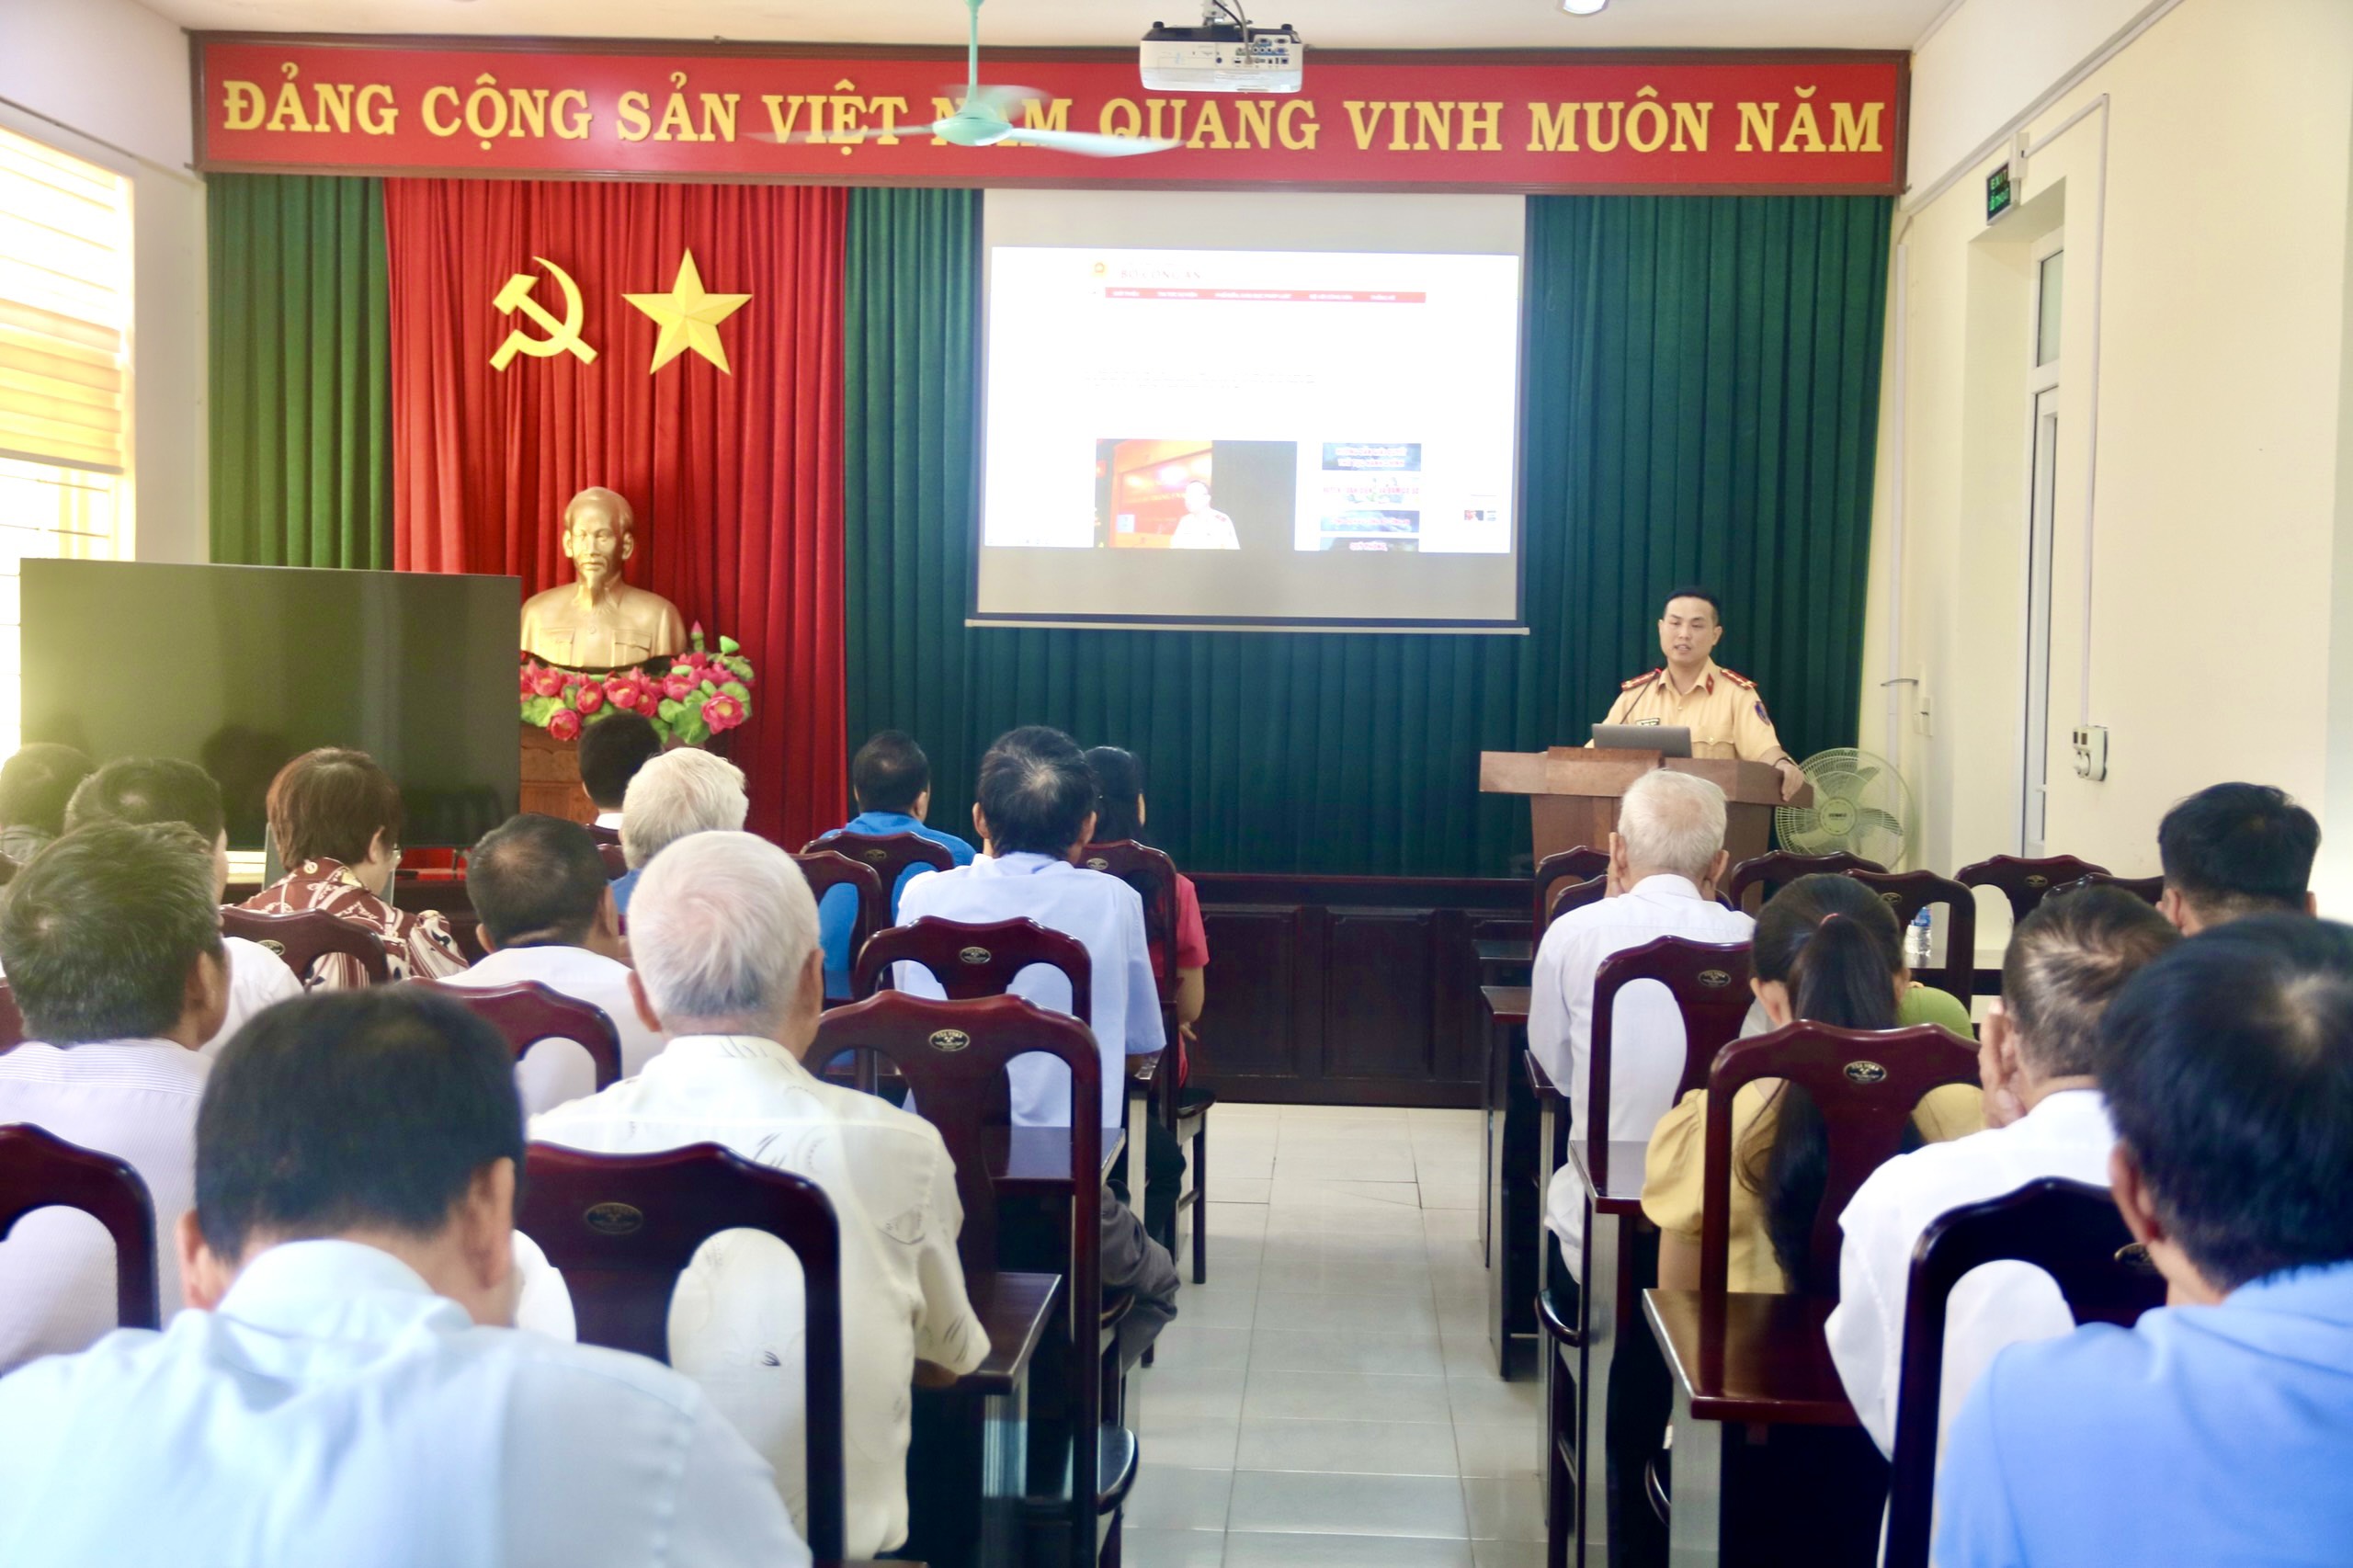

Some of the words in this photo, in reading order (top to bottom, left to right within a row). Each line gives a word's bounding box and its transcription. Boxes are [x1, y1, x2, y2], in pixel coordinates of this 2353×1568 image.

[224, 62, 399, 135] ĐẢNG
[422, 74, 593, 151] CỘNG
[617, 72, 740, 142] SẢN
[762, 79, 908, 155] VIỆT
[1100, 98, 1320, 150] QUANG
[1345, 101, 1504, 151] VINH
[1528, 85, 1712, 153] MUÔN
[1735, 86, 1885, 153] NĂM
